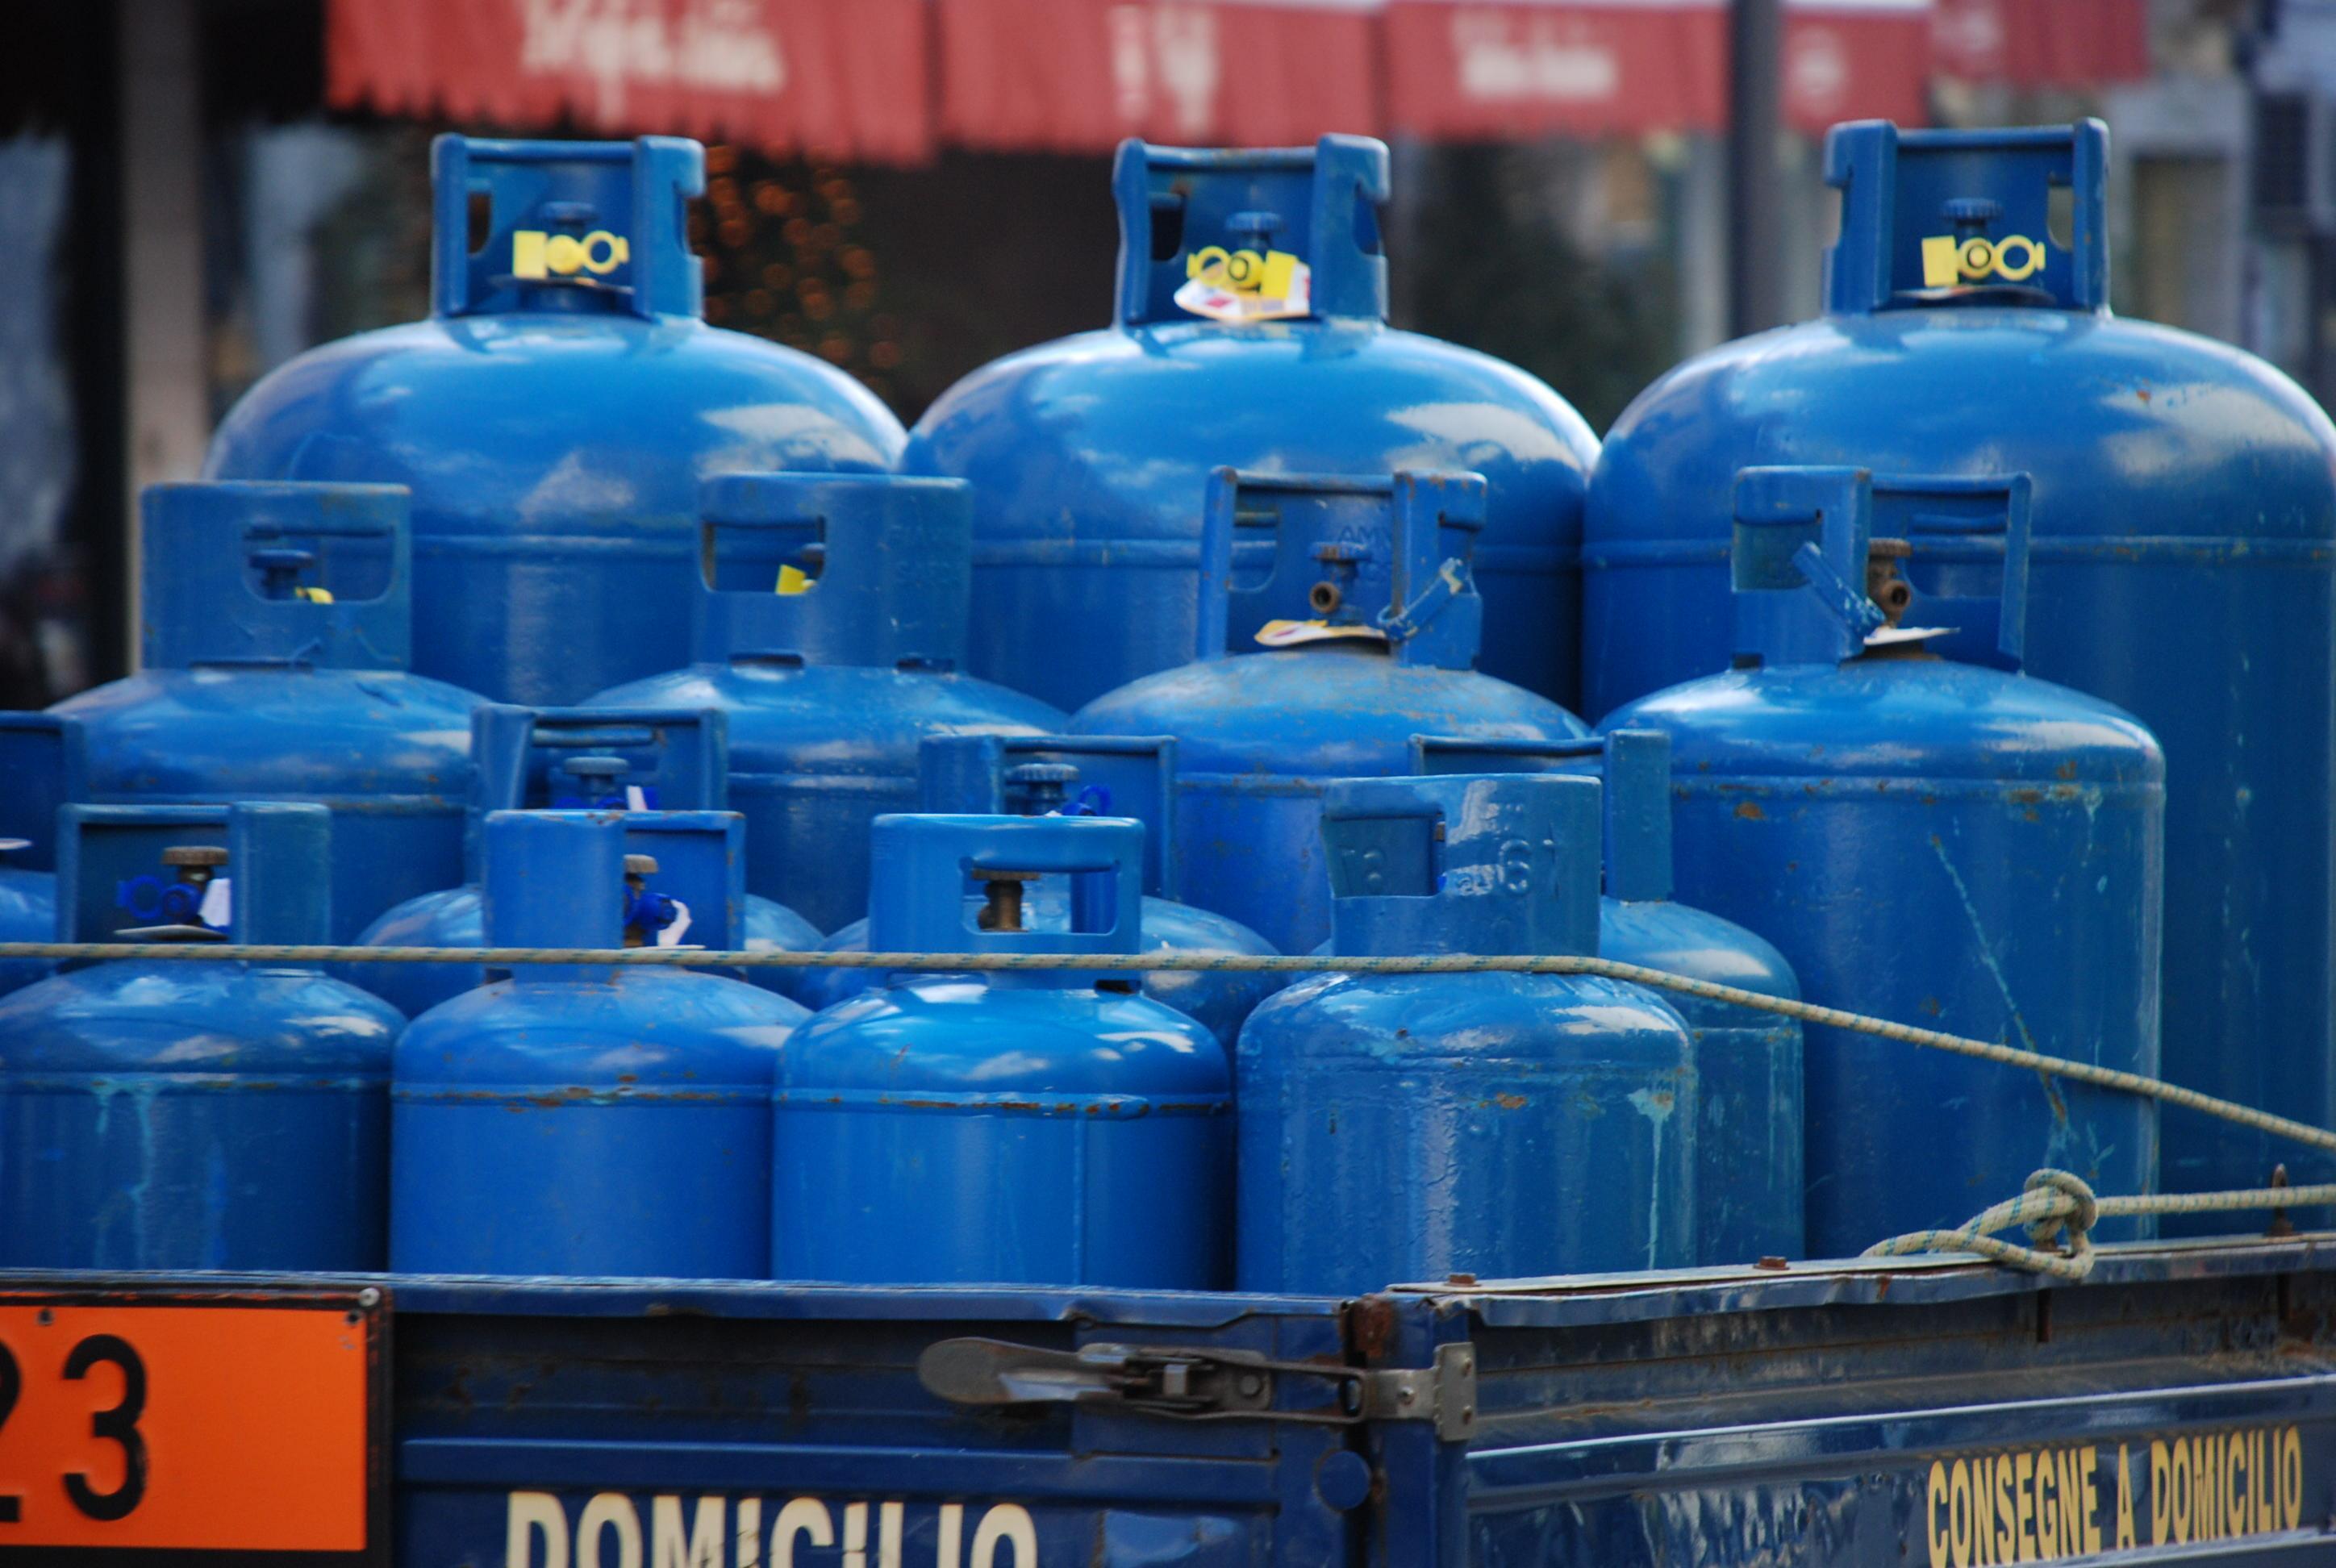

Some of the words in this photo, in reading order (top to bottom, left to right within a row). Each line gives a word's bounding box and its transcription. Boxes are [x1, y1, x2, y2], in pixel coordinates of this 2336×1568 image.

[0, 1333, 148, 1521] 3
[1928, 1445, 2100, 1568] CONSEGNE
[2116, 1442, 2136, 1550] A
[2150, 1425, 2301, 1546] DOMICILIO
